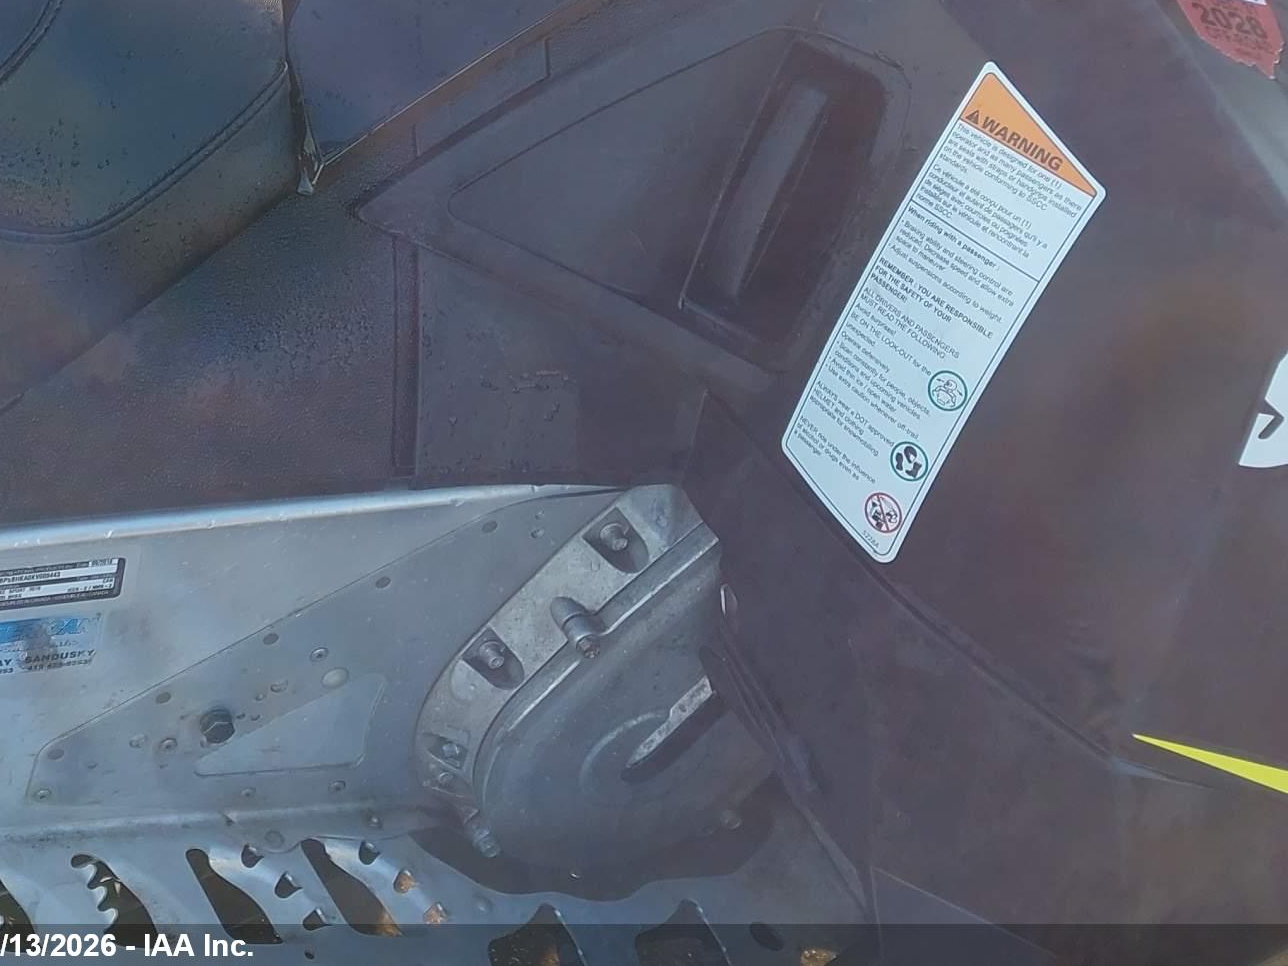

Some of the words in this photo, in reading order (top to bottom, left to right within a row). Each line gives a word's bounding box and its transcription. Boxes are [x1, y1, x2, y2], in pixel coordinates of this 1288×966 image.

[981, 116, 1063, 171] WARNING
[943, 230, 958, 243] with
[961, 243, 996, 268] passenger
[899, 282, 924, 303] SAFETY
[933, 305, 952, 323] YOUR
[944, 303, 993, 339] RESPONSIBLE
[24, 649, 96, 664] SANDUSKY
